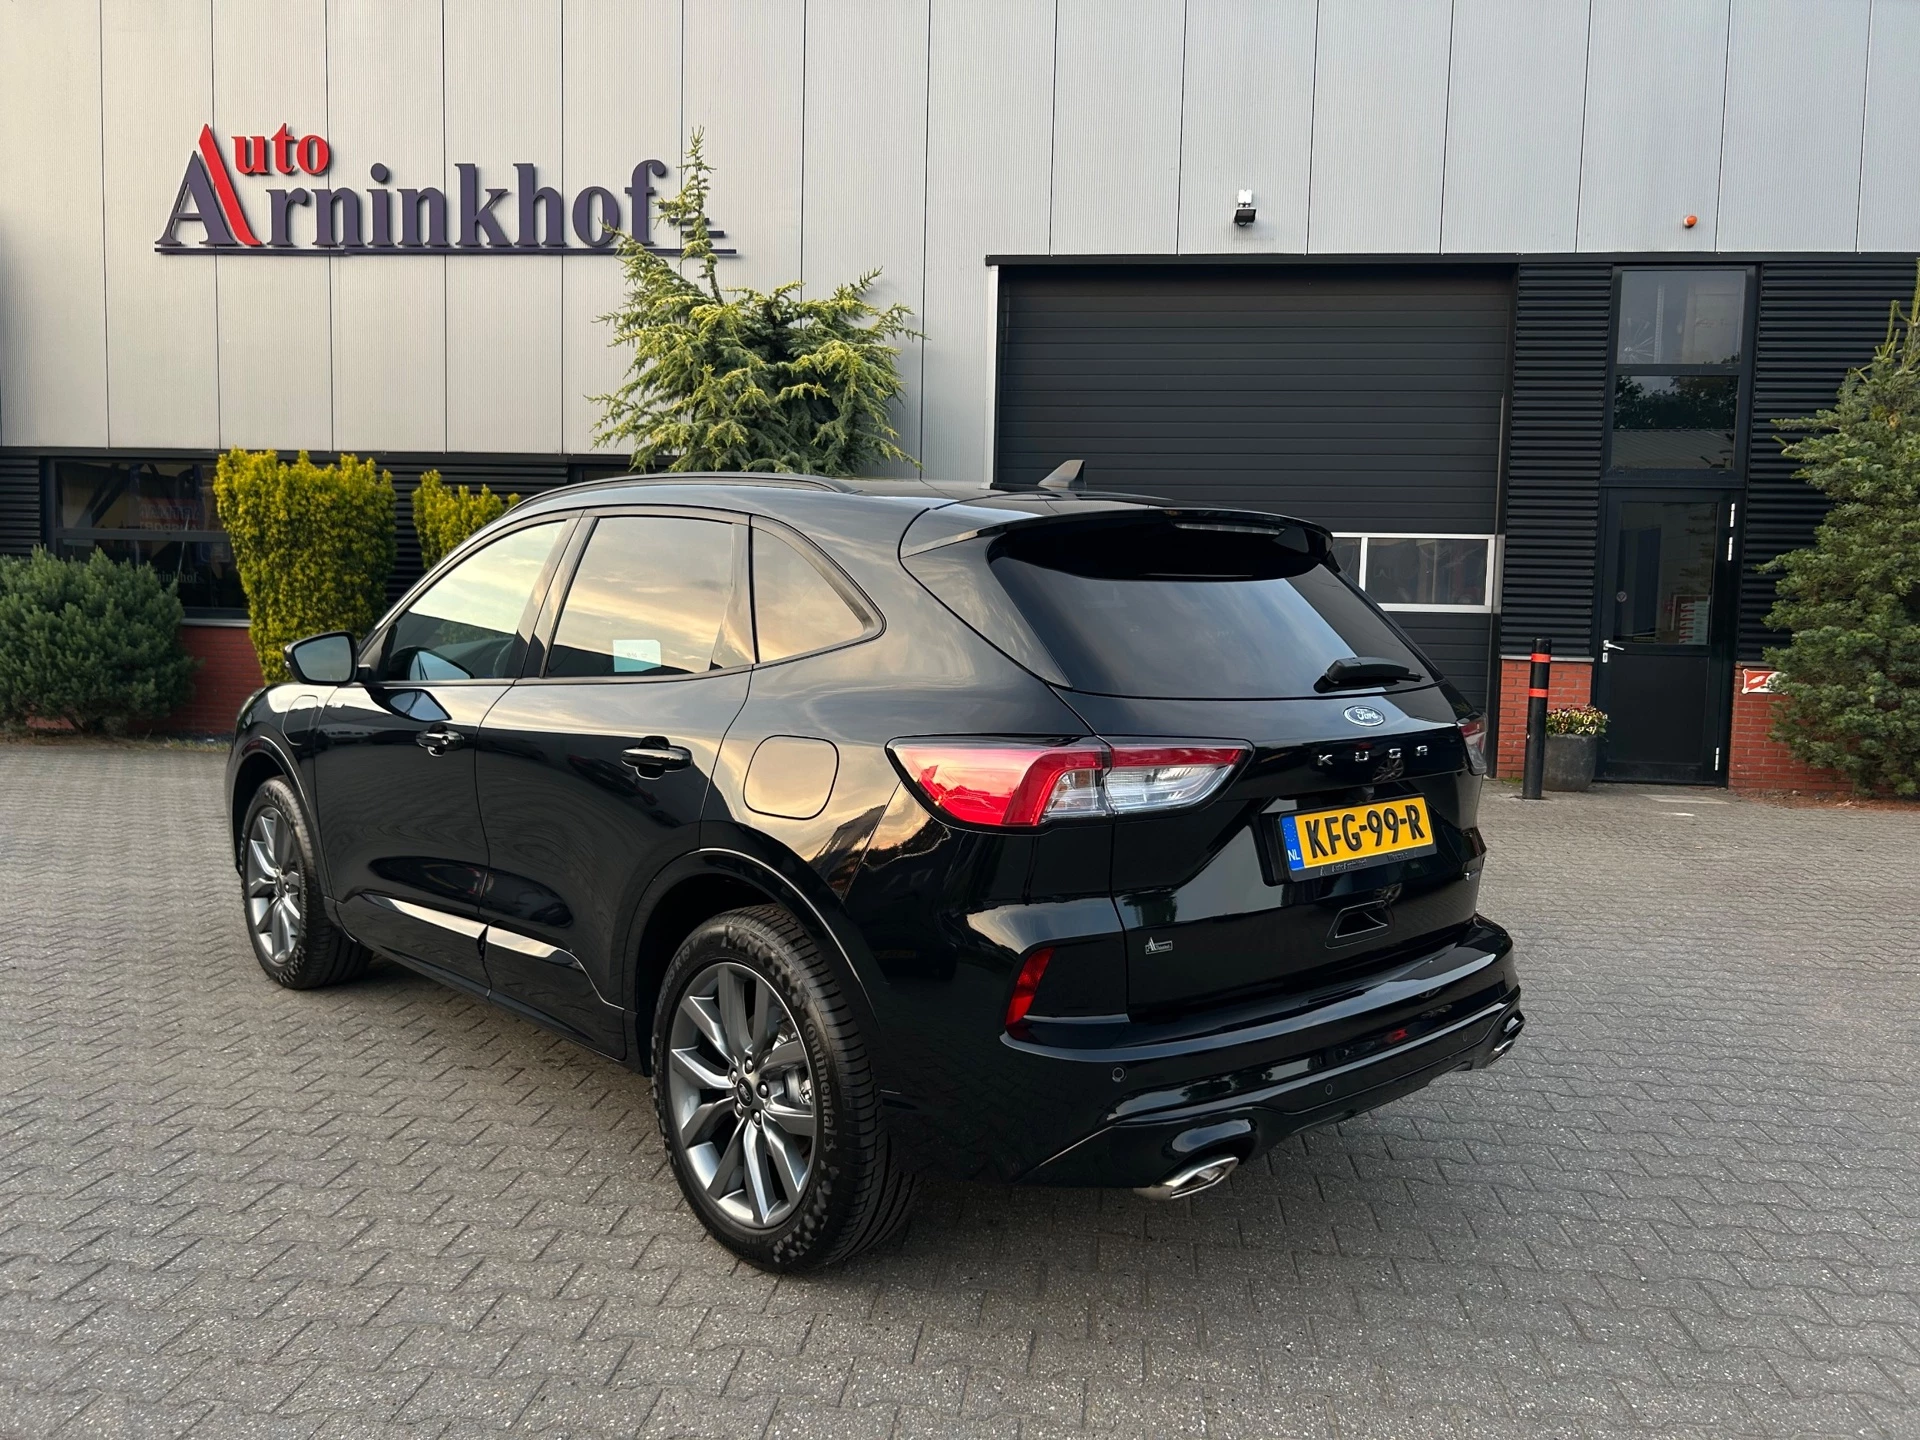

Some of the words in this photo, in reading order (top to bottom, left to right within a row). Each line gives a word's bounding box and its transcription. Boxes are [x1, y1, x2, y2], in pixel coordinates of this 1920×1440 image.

[155, 148, 667, 247] Arninkhof
[1317, 745, 1428, 766] KUGA
[1305, 804, 1425, 859] KFG-99-R
[1287, 849, 1301, 862] NL
